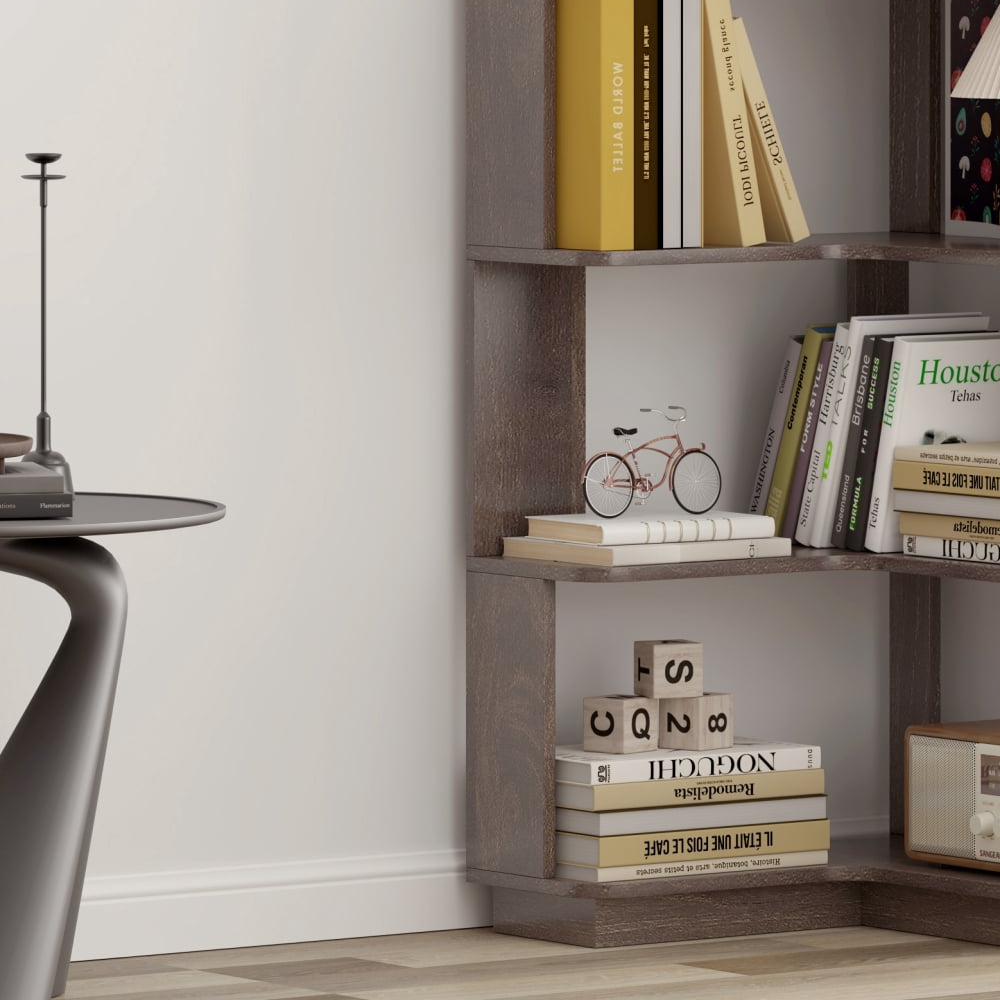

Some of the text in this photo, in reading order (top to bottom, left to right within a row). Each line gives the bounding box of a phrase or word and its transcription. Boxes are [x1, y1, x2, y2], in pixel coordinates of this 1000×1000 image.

[787, 355, 808, 430] Contemporan
[819, 341, 844, 425] Harrisburg
[852, 354, 871, 426] Brisbane
[883, 360, 902, 428] Houston
[950, 388, 981, 402] Tehas
[800, 411, 814, 453] FORM
[849, 356, 880, 531] FORMULA FOR SUCCESS
[750, 427, 776, 513] WASHINGTON
[800, 449, 821, 528] State Capital
[835, 474, 850, 533] Queensland
[869, 496, 880, 529] Tehas
[638, 657, 650, 682] T
[664, 659, 694, 684] S
[590, 710, 615, 737] C
[631, 708, 651, 740] Q
[667, 712, 691, 734] 2
[708, 712, 728, 733] 8
[649, 751, 777, 780] NOGUCHI
[674, 783, 755, 801] Remodelista
[644, 830, 774, 860] IL ÉTAIT UNE FOIS LE CAFÉ
[636, 857, 781, 876] Histoire, botanique, arts et petits secrets
